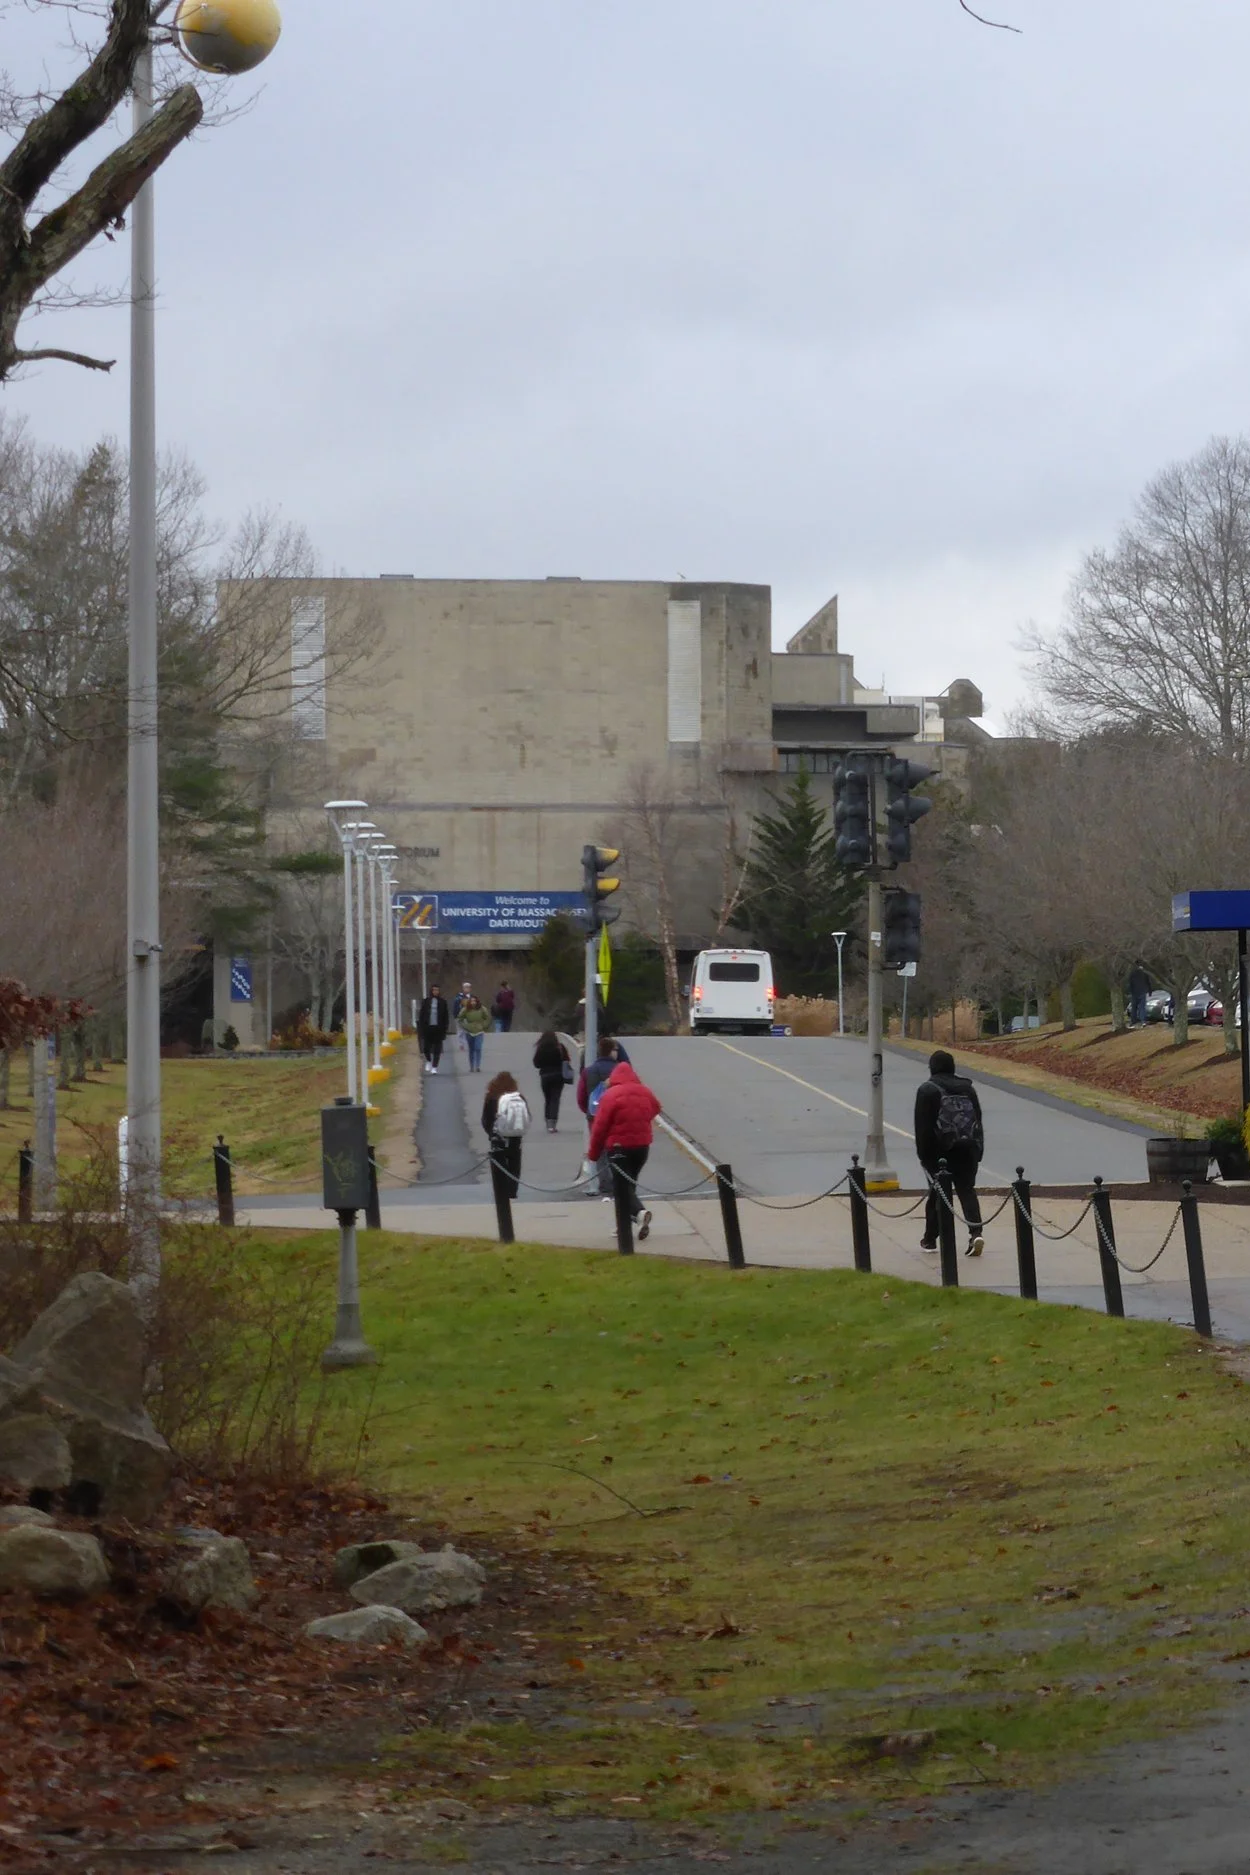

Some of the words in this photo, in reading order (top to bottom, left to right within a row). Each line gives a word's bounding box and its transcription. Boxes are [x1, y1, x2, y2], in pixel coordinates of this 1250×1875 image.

[495, 896, 538, 905] Welcome
[540, 896, 550, 905] to
[442, 908, 499, 916] UNIVERSITY
[501, 908, 516, 916] OF
[489, 919, 548, 928] DARTMOUT
